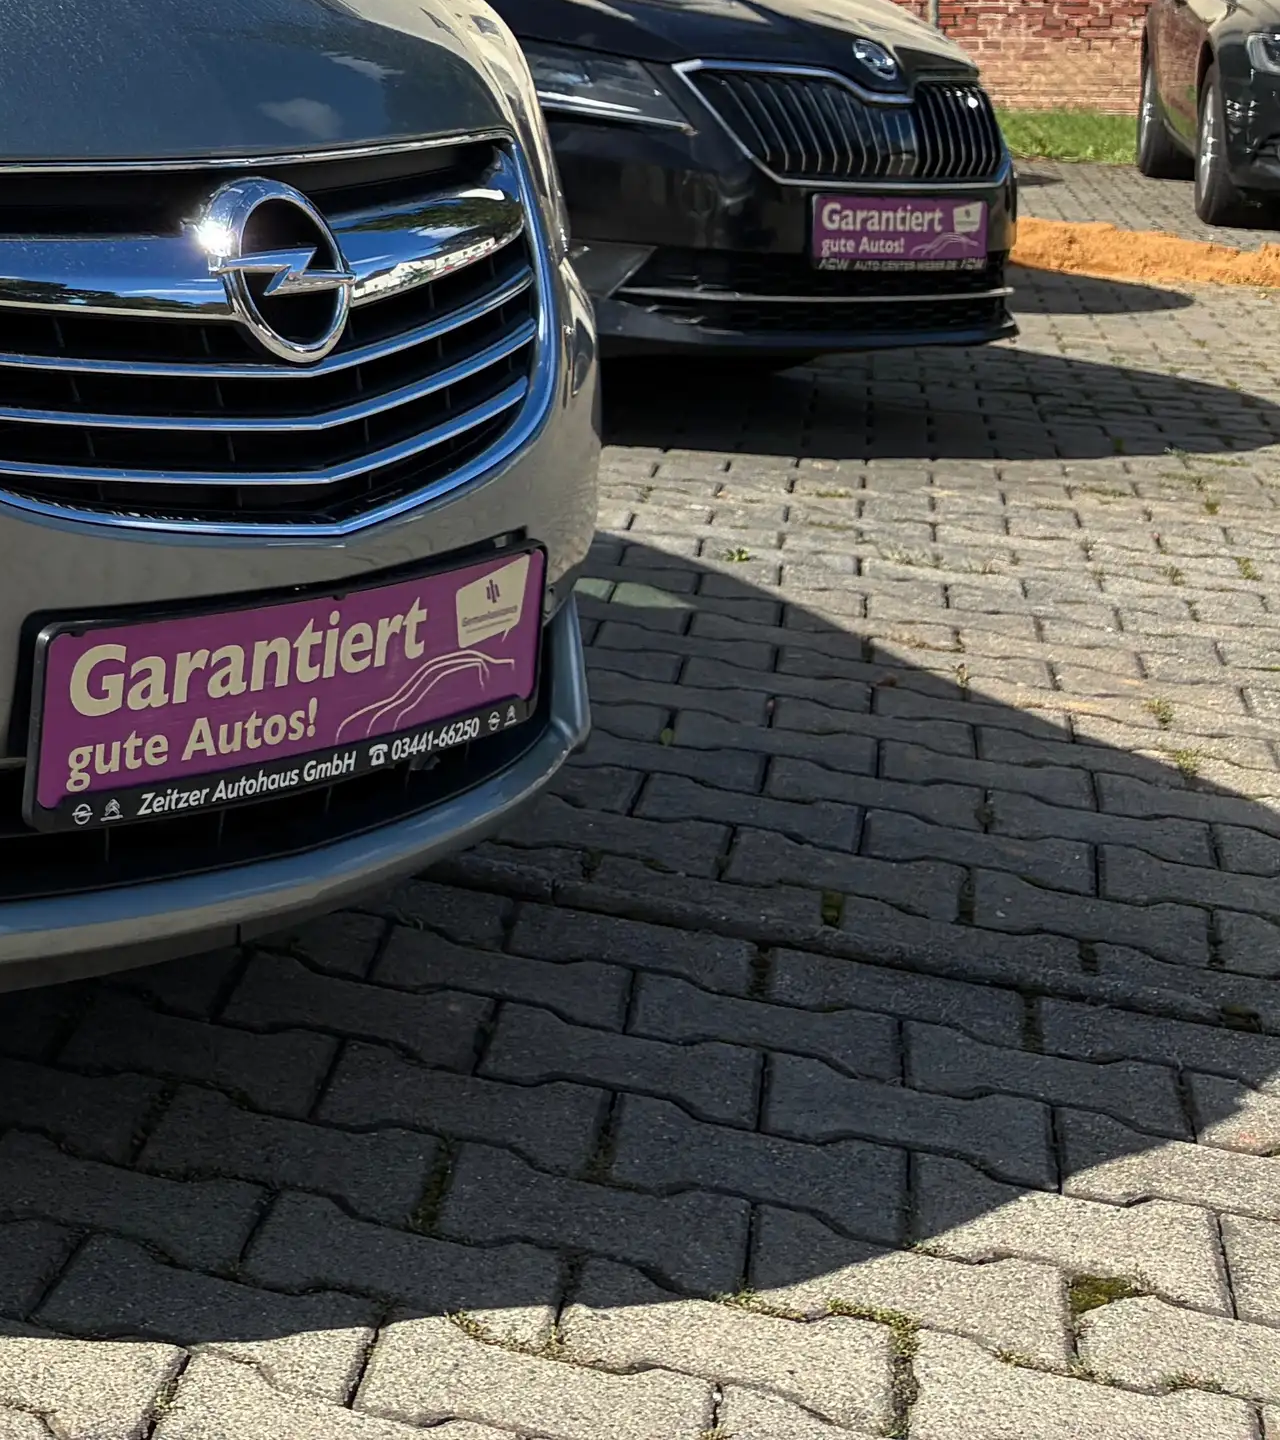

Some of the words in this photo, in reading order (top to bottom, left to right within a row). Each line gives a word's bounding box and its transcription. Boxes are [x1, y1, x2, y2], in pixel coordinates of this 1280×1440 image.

[821, 236, 856, 257] gute
[858, 236, 905, 254] Autos!
[822, 202, 944, 233] Garantiert
[69, 596, 428, 717] Garantiert
[65, 730, 169, 792] gute
[181, 697, 318, 761] Autos!
[136, 785, 210, 816] Zeitzer
[211, 766, 300, 802] Autohaus
[303, 751, 357, 782] GmbH
[391, 717, 480, 761] 03441-66250
